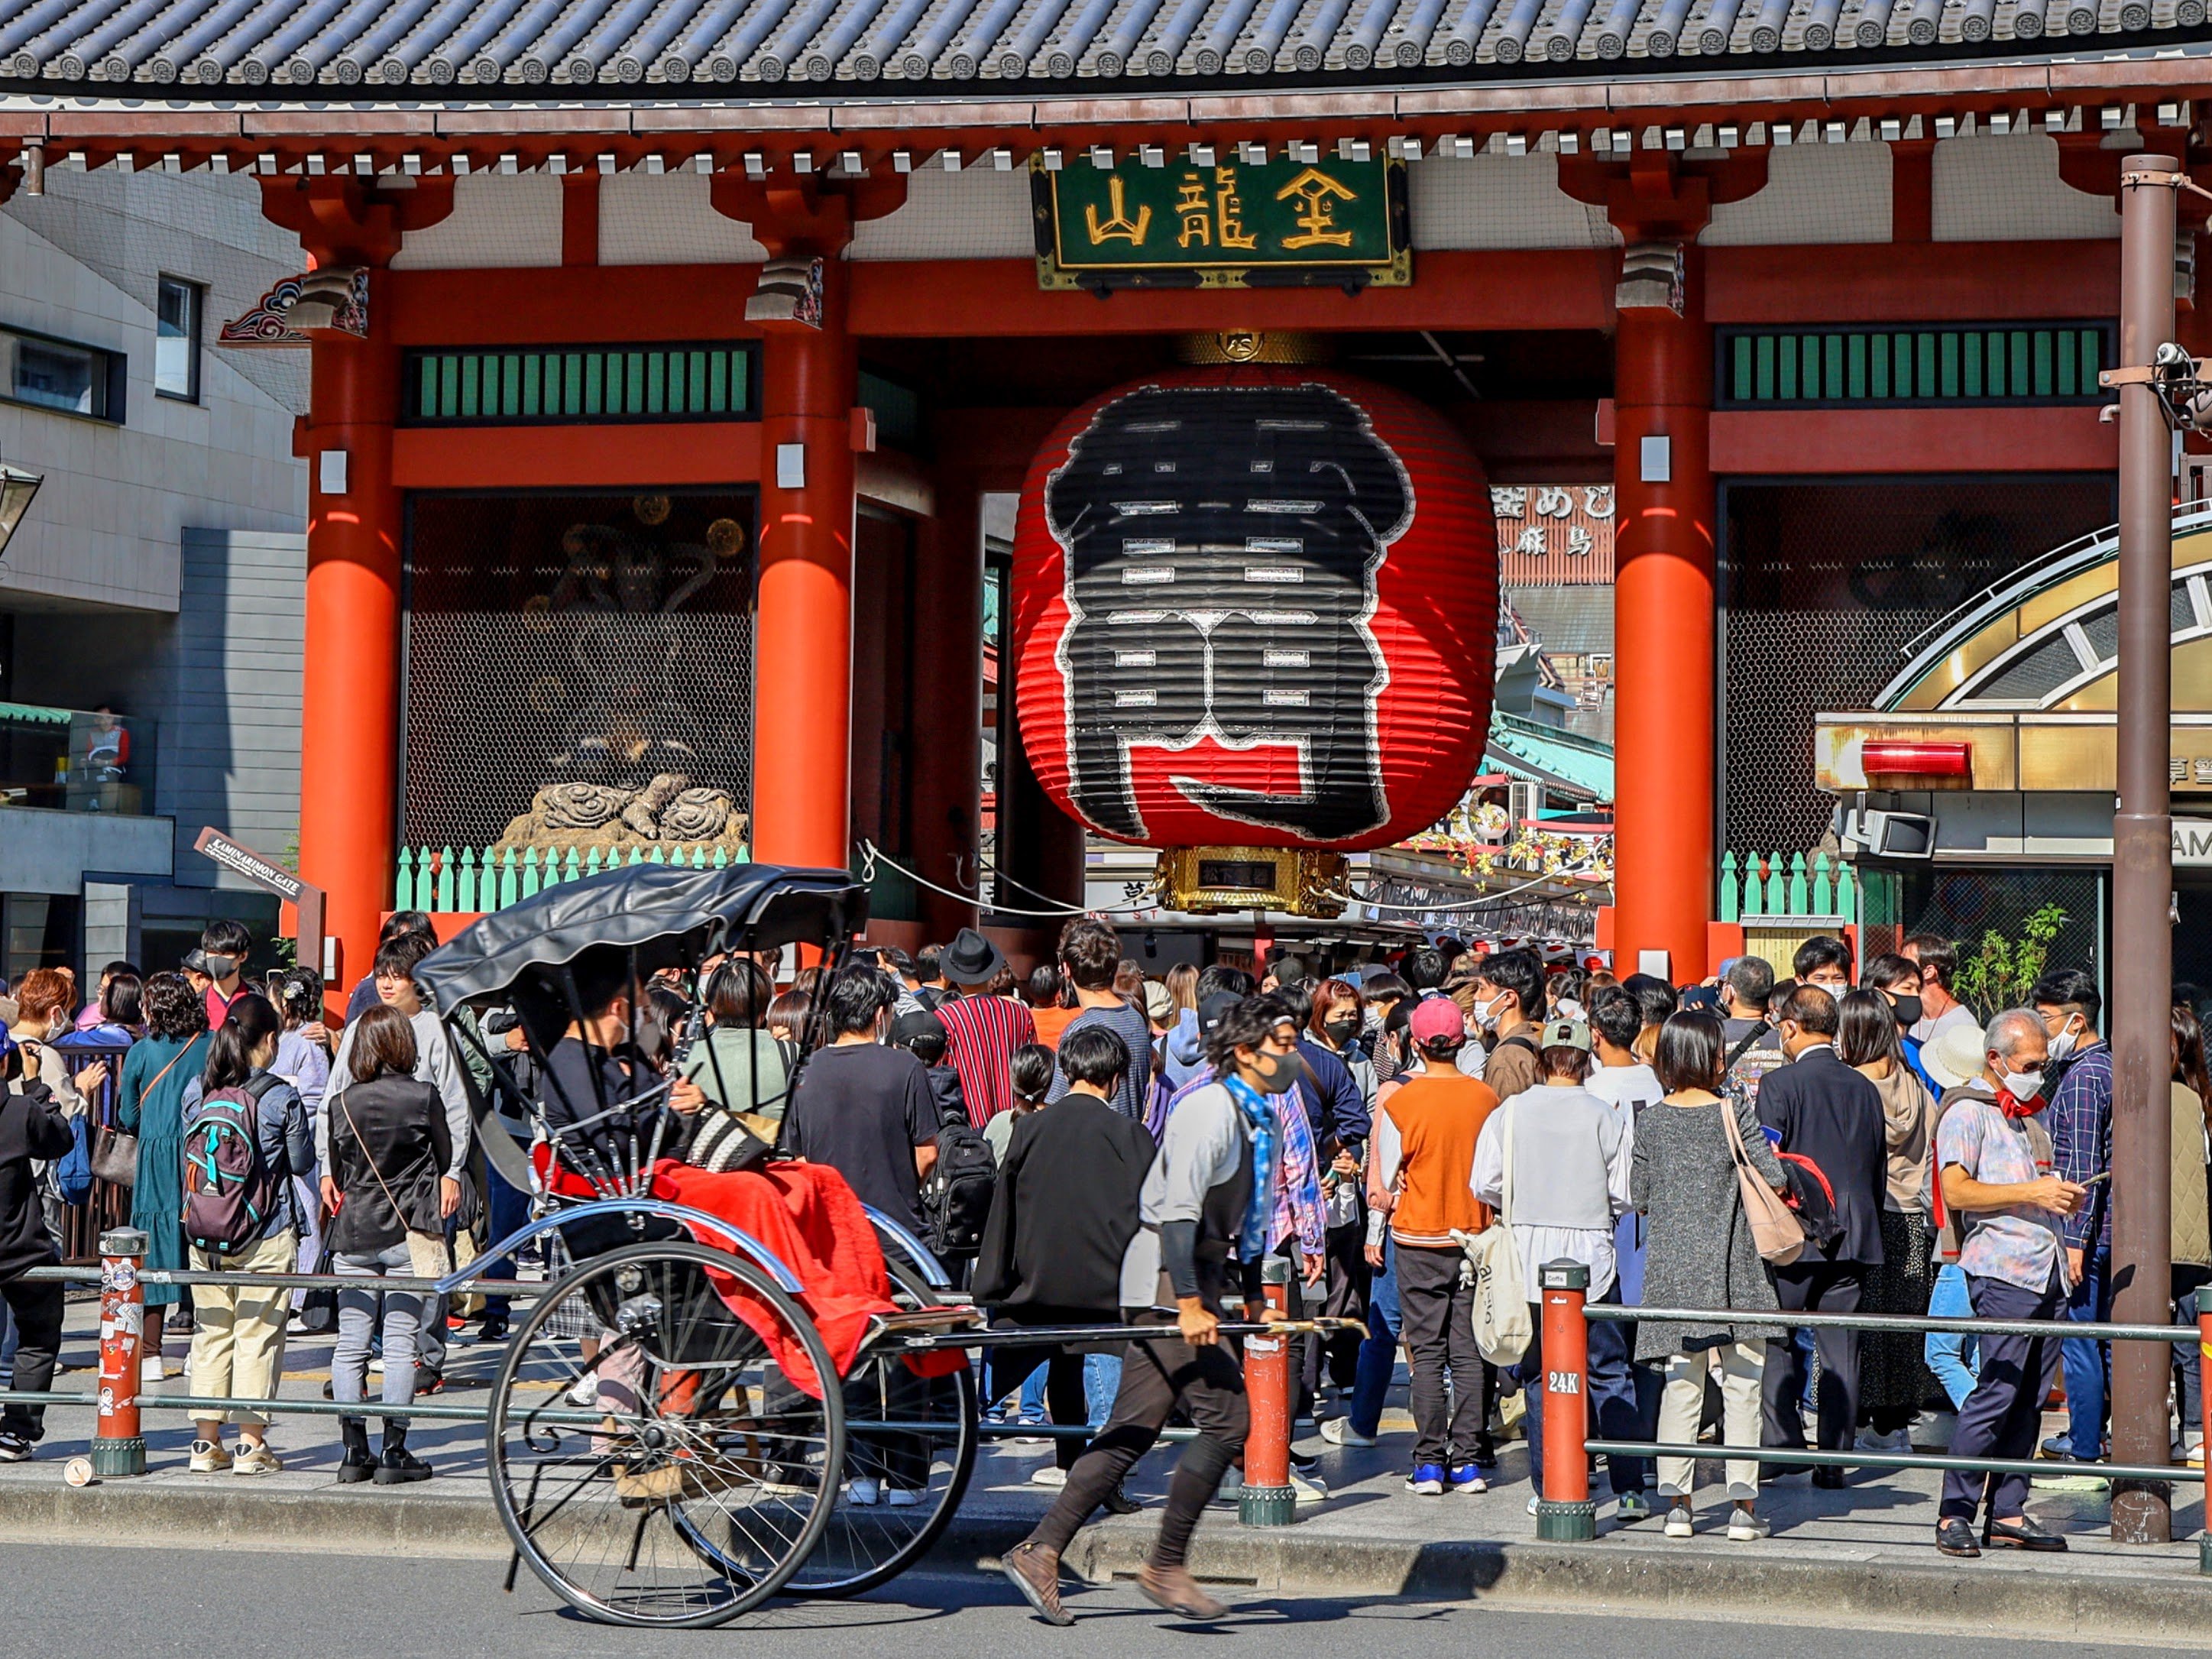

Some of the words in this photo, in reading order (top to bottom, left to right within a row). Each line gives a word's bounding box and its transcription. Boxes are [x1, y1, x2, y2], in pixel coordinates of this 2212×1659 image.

[1044, 382, 1417, 842] 雷門
[212, 838, 277, 879] KAMINARIMON
[274, 873, 300, 892] GATE
[1549, 1372, 1579, 1395] 24K
